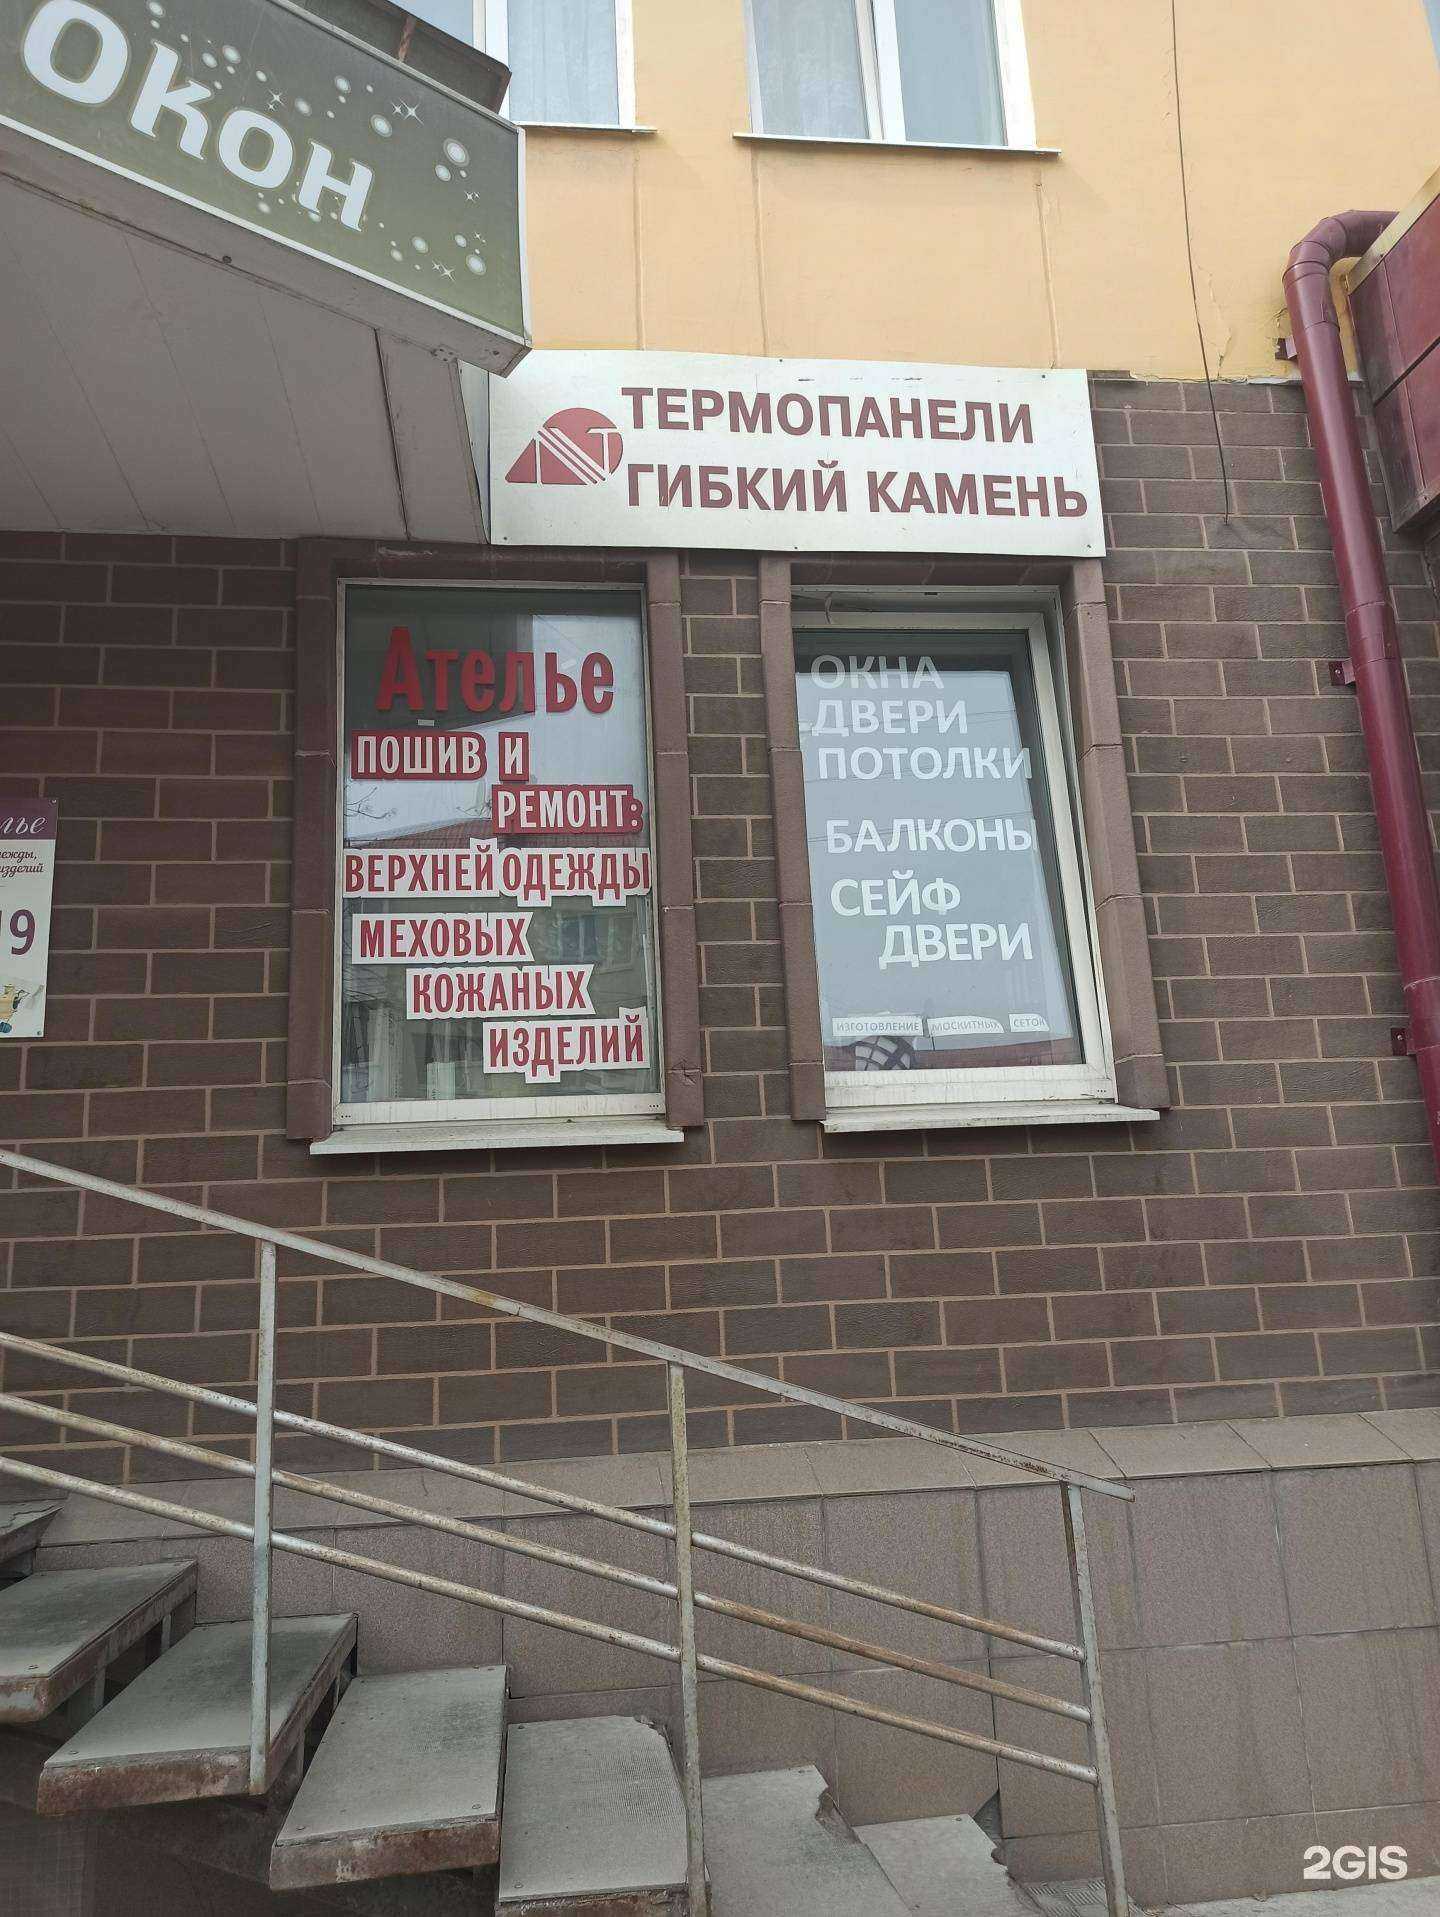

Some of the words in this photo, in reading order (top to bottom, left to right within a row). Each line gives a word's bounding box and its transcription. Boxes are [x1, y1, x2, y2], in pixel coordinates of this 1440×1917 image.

[621, 387, 1034, 444] ТЕРМОПАНЕЛИ
[627, 459, 847, 513] ГИБКИЙ
[867, 471, 1088, 518] КАМЕНЬ
[375, 626, 614, 714] Ателье
[810, 655, 945, 690] ОКНА
[811, 699, 968, 737] ДВЕРИ
[357, 735, 481, 774] ПОШИВ
[503, 737, 523, 775] И
[818, 746, 1033, 780] ПОТОЛКИ
[498, 790, 639, 828] РЕМОНТ:
[345, 844, 493, 892] ВЕРХНЕЙ
[502, 853, 650, 901] ОДЕЖДЫ
[830, 869, 961, 916] СЕЙФ
[360, 918, 526, 958] МЕХОВЫХ
[878, 922, 1033, 970] ДВЕРИ
[412, 970, 587, 1013] КОЖАНЫХ
[489, 1013, 644, 1077] ИЗДЕЛИЙ
[836, 1021, 920, 1032] ИЗГОТОВЛЕНИЕ
